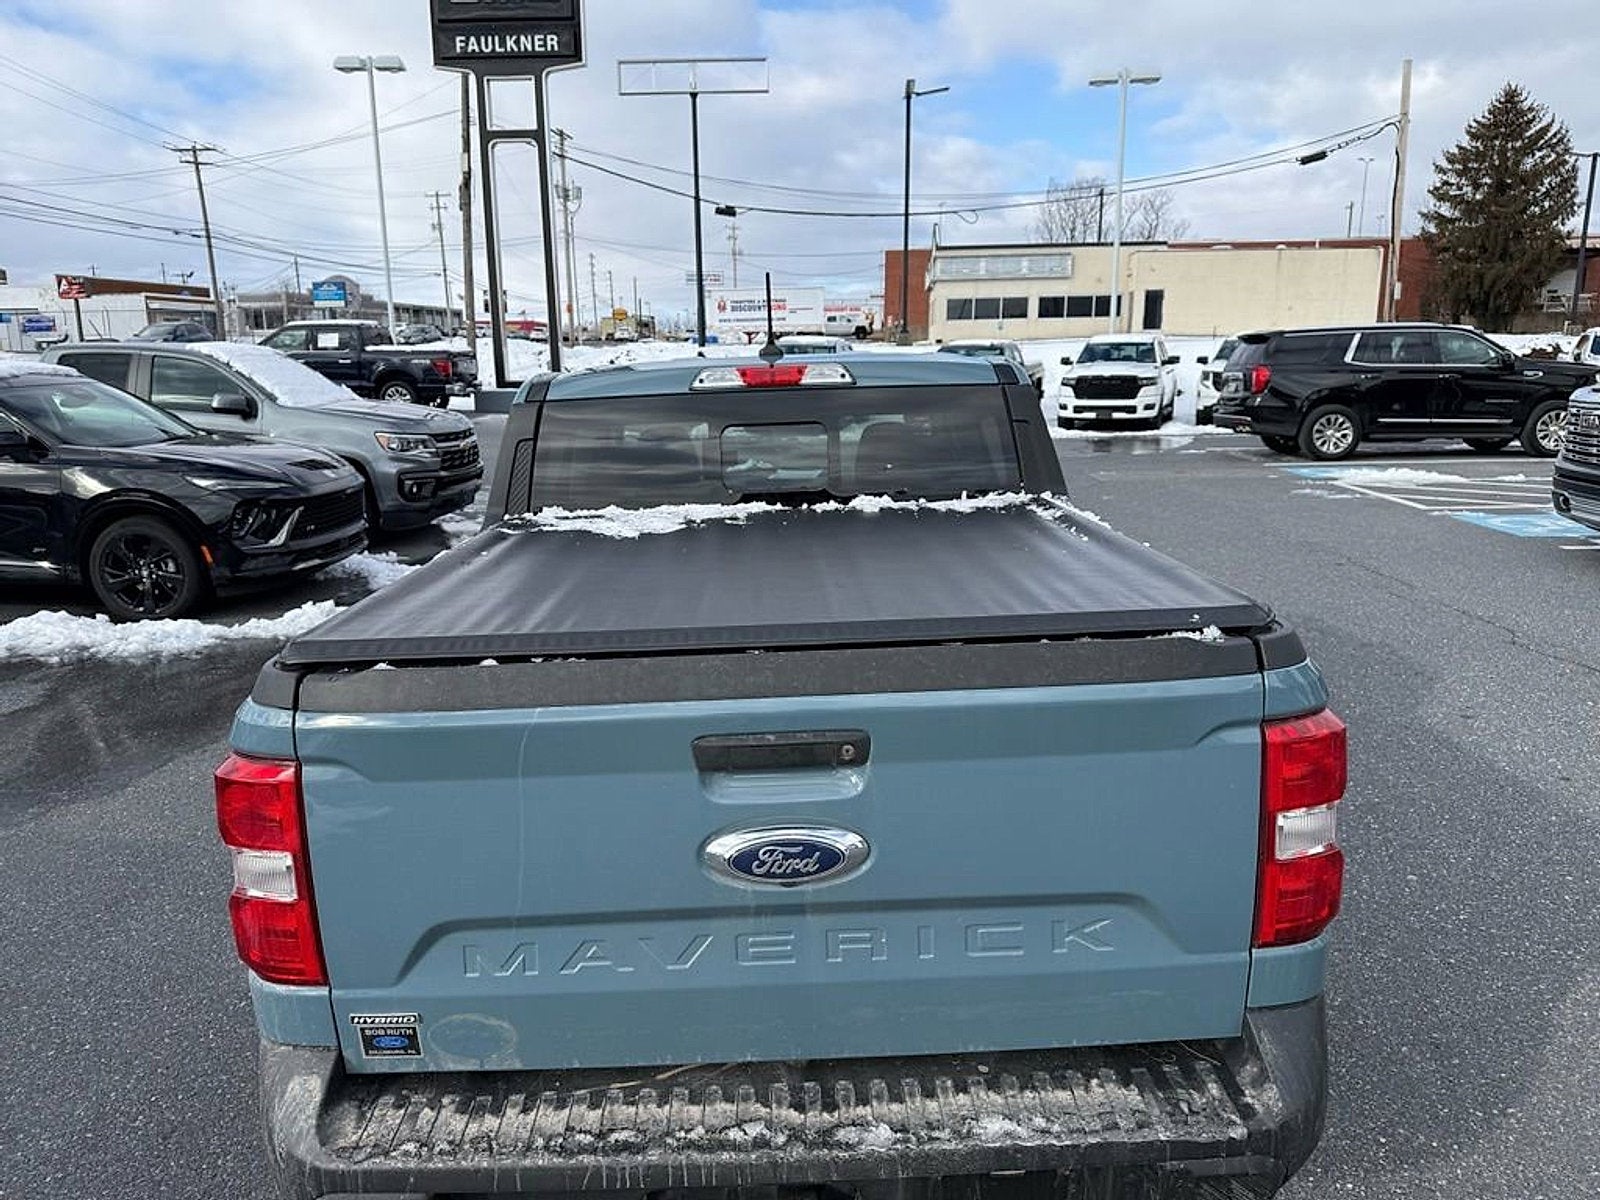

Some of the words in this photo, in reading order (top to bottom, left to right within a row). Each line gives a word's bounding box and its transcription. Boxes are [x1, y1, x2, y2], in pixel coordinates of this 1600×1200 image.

[455, 34, 559, 53] FAULKNER
[752, 846, 821, 875] Ford
[463, 919, 1114, 977] MAVERICK
[353, 1016, 416, 1025] HYBRID
[364, 1028, 386, 1036] BOB
[387, 1027, 414, 1036] RUTH
